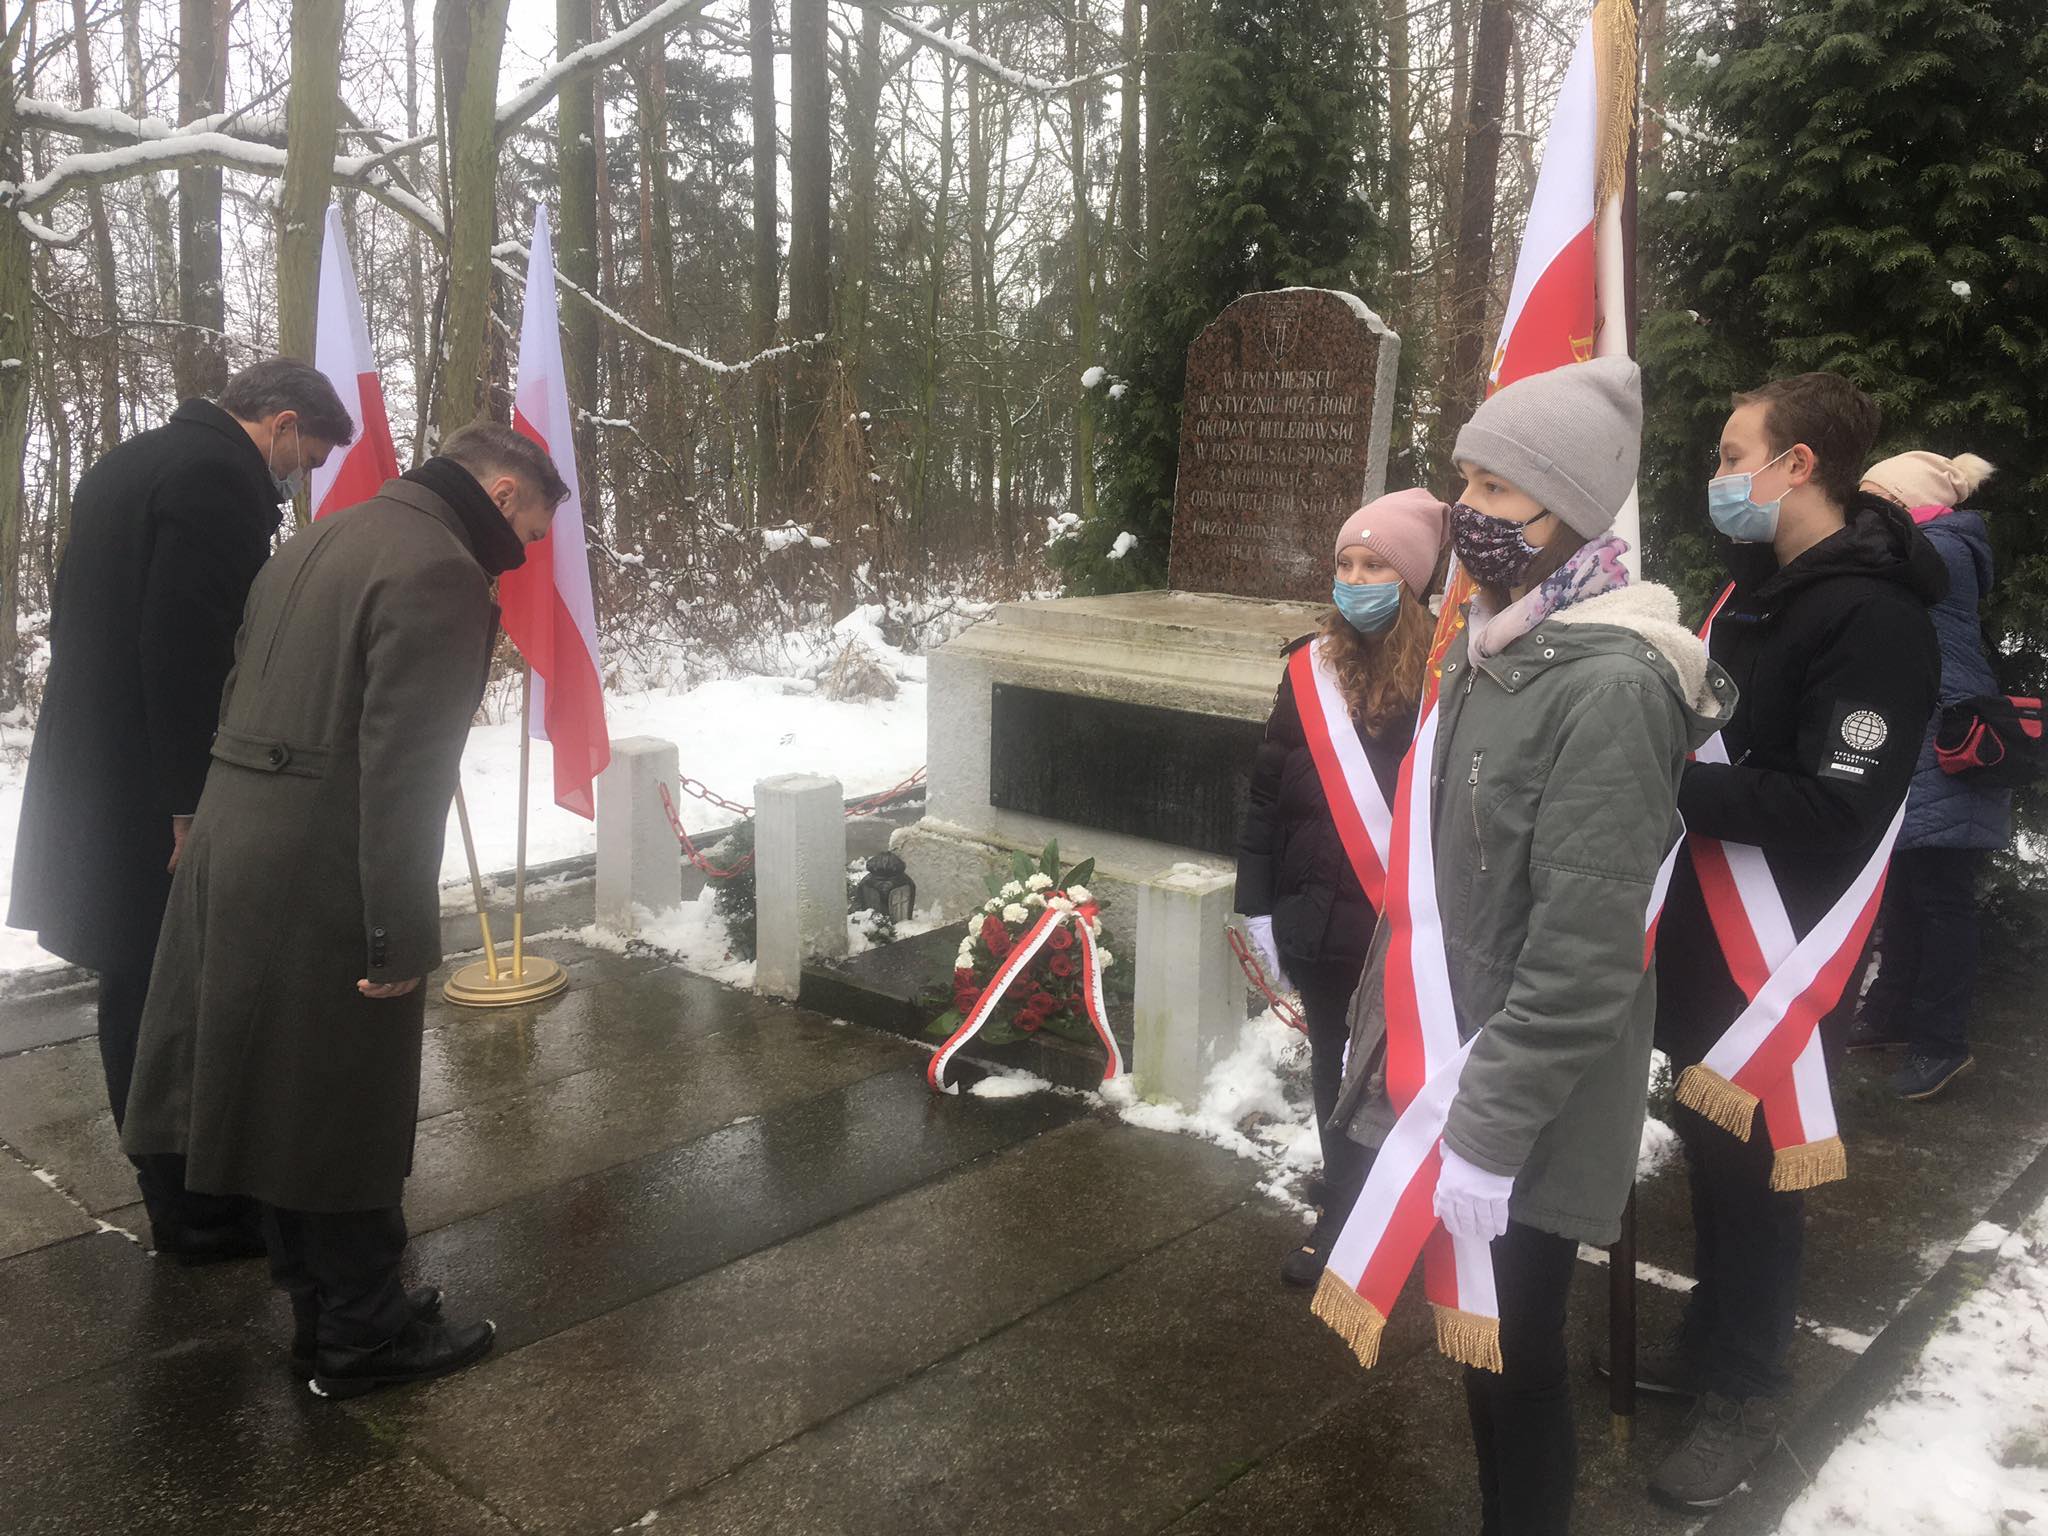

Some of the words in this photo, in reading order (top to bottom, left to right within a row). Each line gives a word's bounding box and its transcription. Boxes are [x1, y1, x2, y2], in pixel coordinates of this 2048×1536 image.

[1223, 370, 1238, 389] W
[1241, 370, 1270, 389] TYM
[1273, 370, 1337, 391] MIEJSCU
[1199, 395, 1213, 413] W
[1283, 396, 1315, 414] 1945
[1318, 396, 1360, 415] ROKU
[1195, 420, 1256, 438] OKUPANT
[1259, 421, 1354, 440] HITLEROWSKI
[1834, 751, 1880, 765] EXPLORATION
